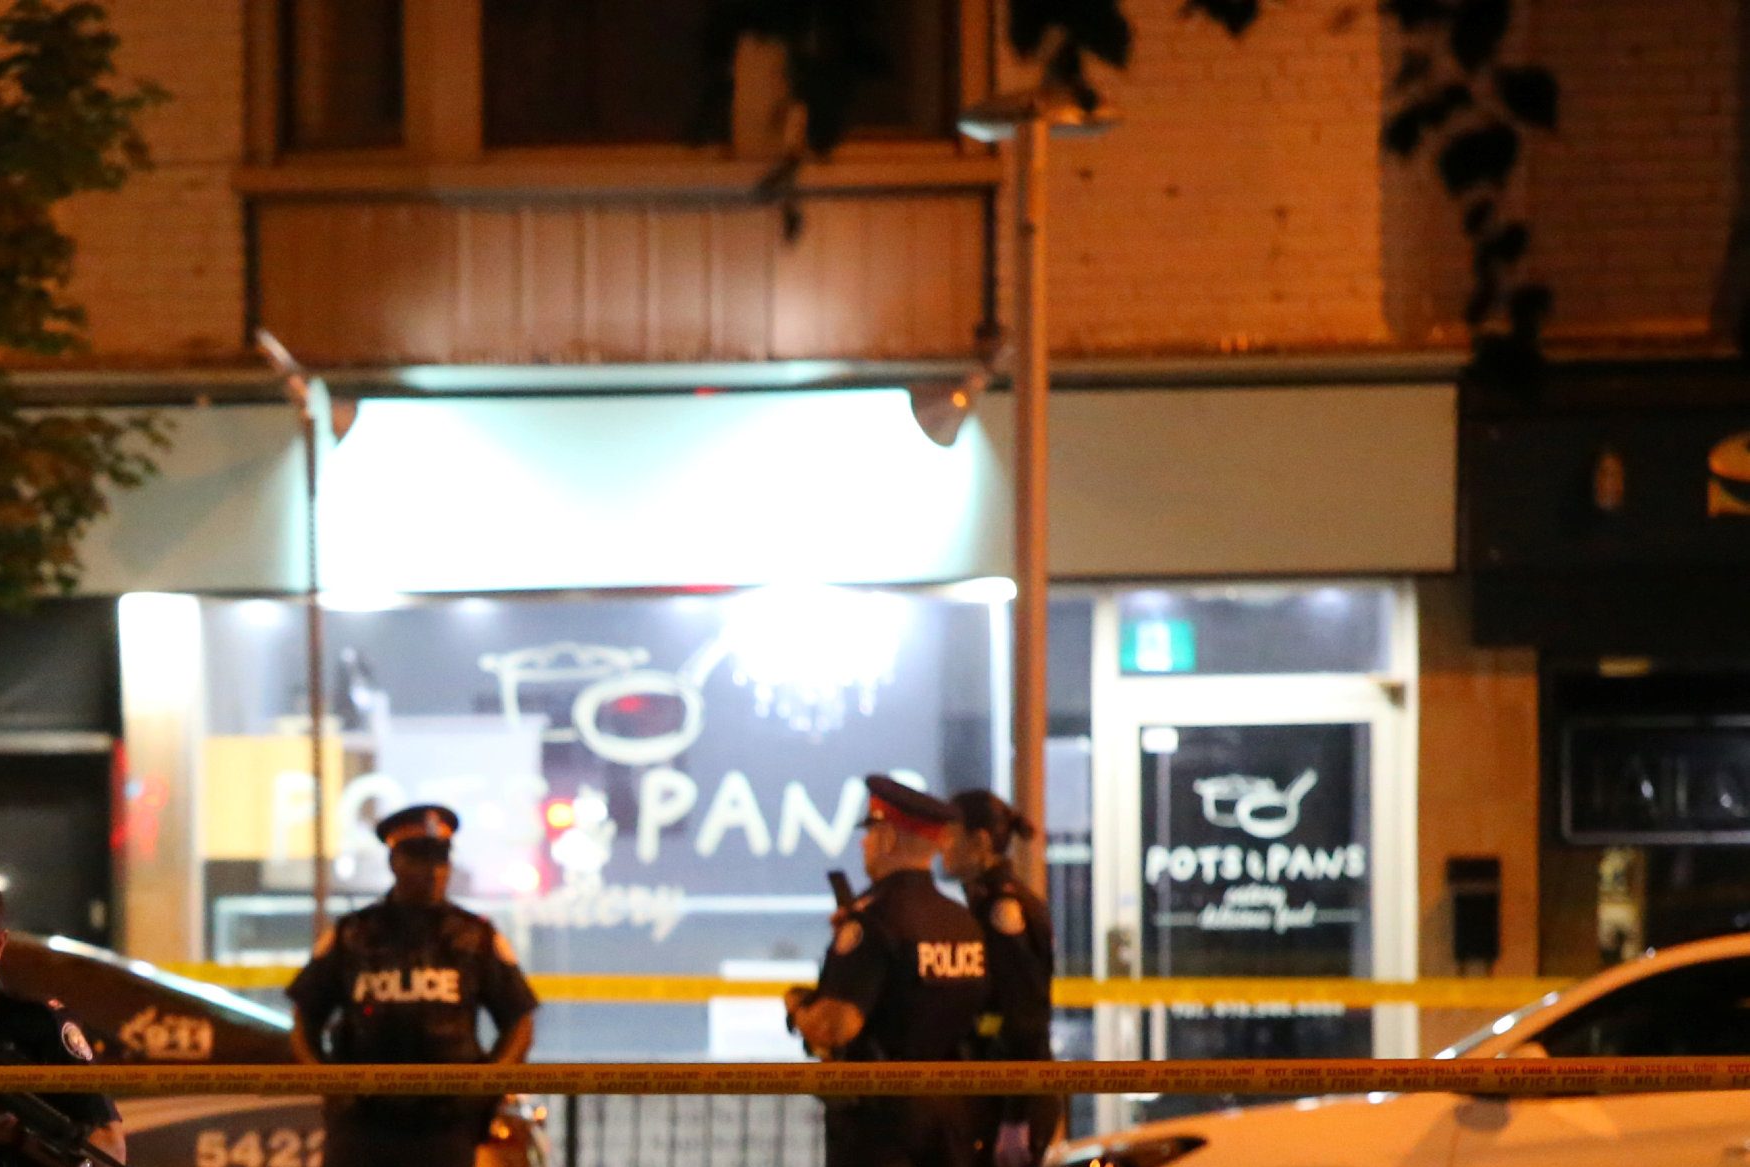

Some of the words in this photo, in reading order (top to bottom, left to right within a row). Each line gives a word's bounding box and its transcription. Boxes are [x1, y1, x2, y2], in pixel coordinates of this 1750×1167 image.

[635, 766, 929, 866] PAN
[1146, 845, 1243, 885] POTS
[1266, 843, 1366, 883] PANS
[917, 941, 986, 978] POLICE
[353, 967, 461, 1004] POLICE
